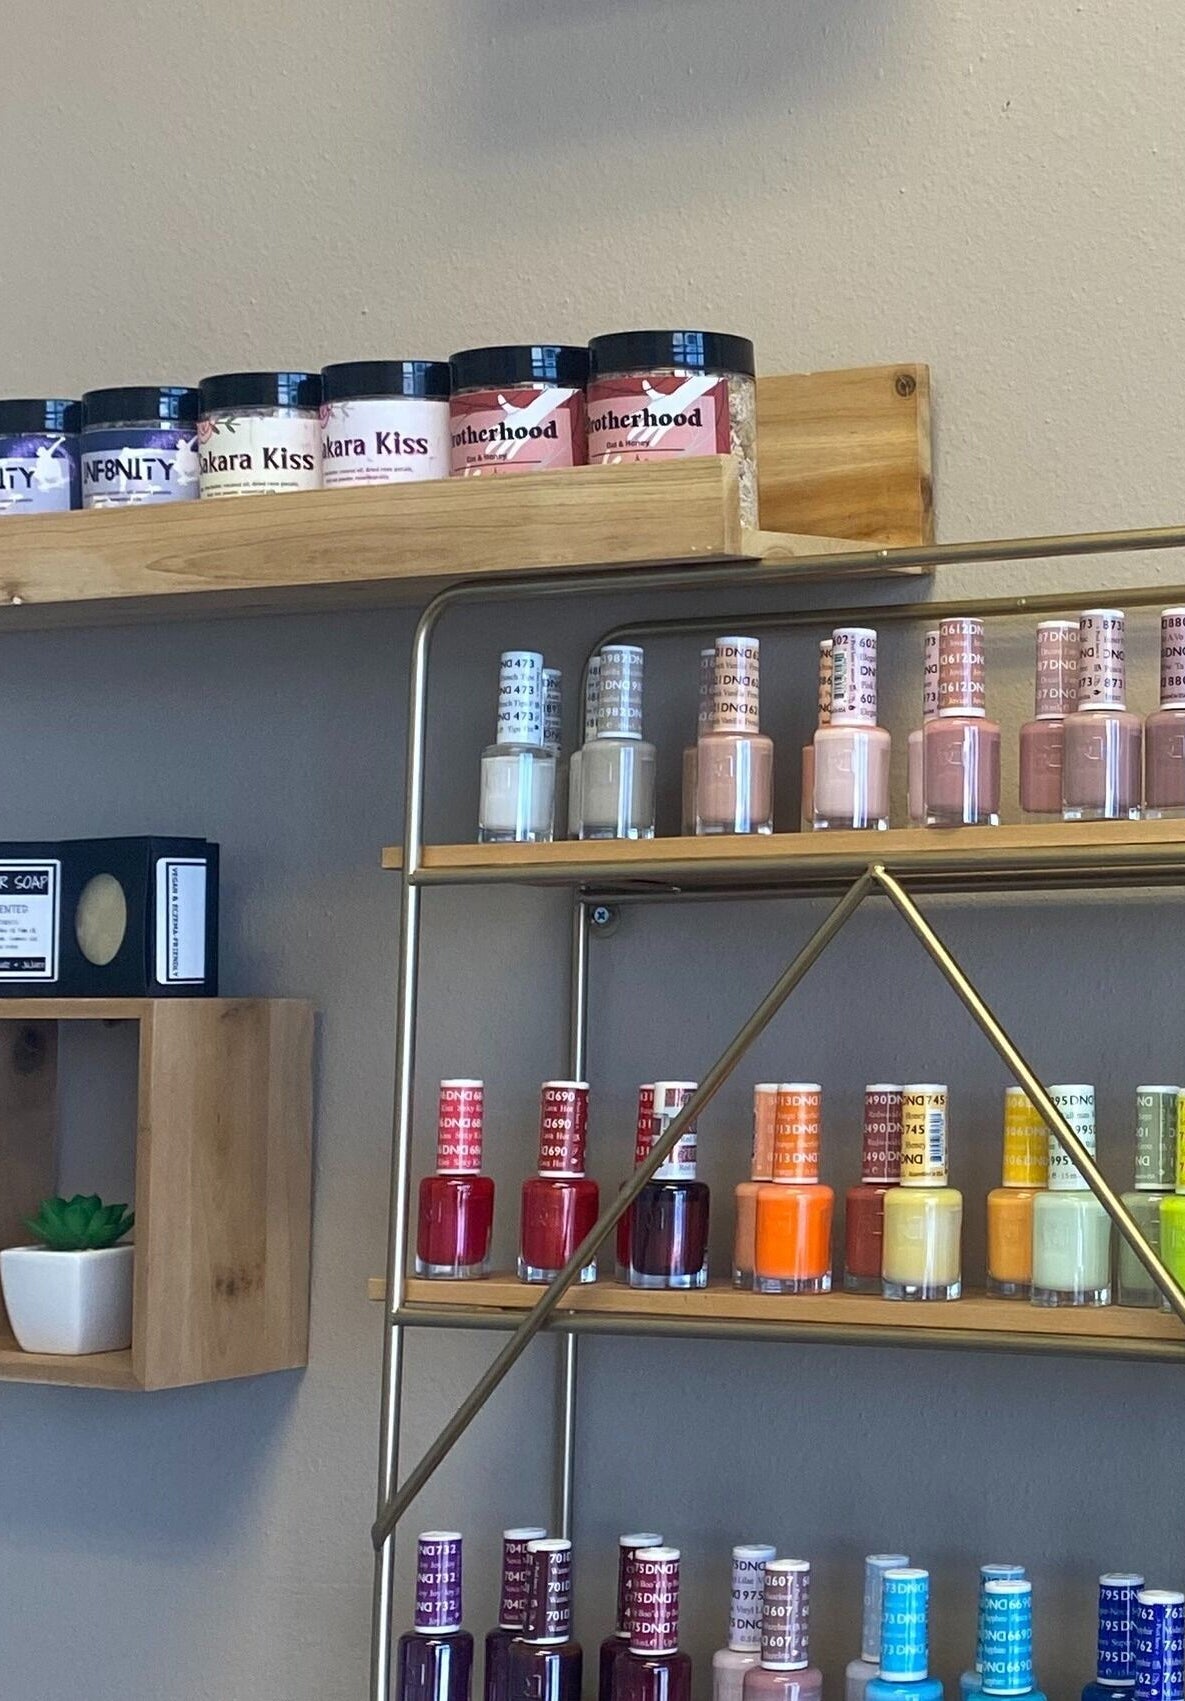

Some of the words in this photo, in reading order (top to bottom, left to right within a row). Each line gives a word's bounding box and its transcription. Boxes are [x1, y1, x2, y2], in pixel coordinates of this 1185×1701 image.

[585, 408, 702, 433] rotherhood
[375, 431, 428, 455] Kiss
[262, 448, 314, 471] Kiss
[14, 875, 49, 889] SOAP
